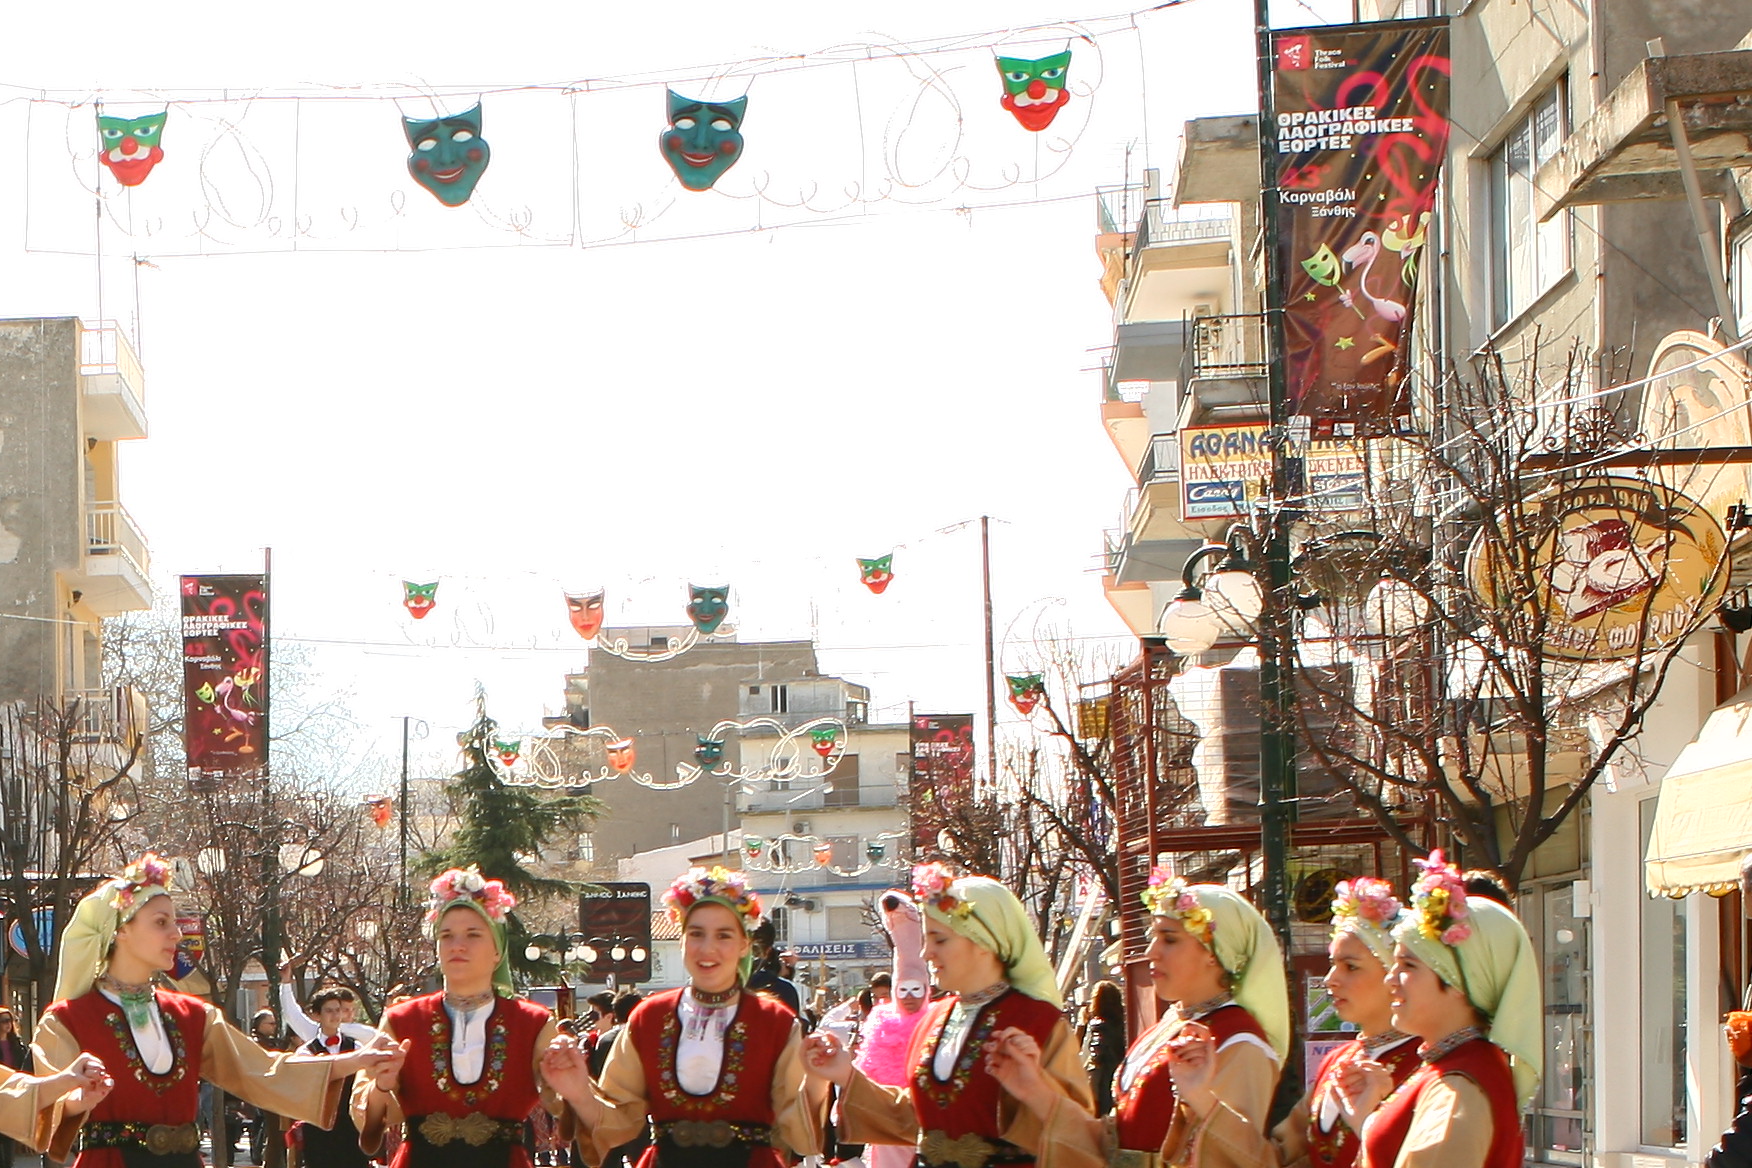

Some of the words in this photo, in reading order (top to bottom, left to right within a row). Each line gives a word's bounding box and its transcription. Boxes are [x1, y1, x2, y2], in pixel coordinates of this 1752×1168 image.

[1277, 106, 1376, 126] ΘΡΑΚΙΚΕΣ
[1278, 118, 1414, 140] ΛΑΟΓΡΑΦΙΚΕΣ
[1279, 136, 1352, 153] ΕΟΡΤΕΣ
[1279, 187, 1356, 205] Καρναβάλι
[1311, 205, 1356, 217] Ξάνθης
